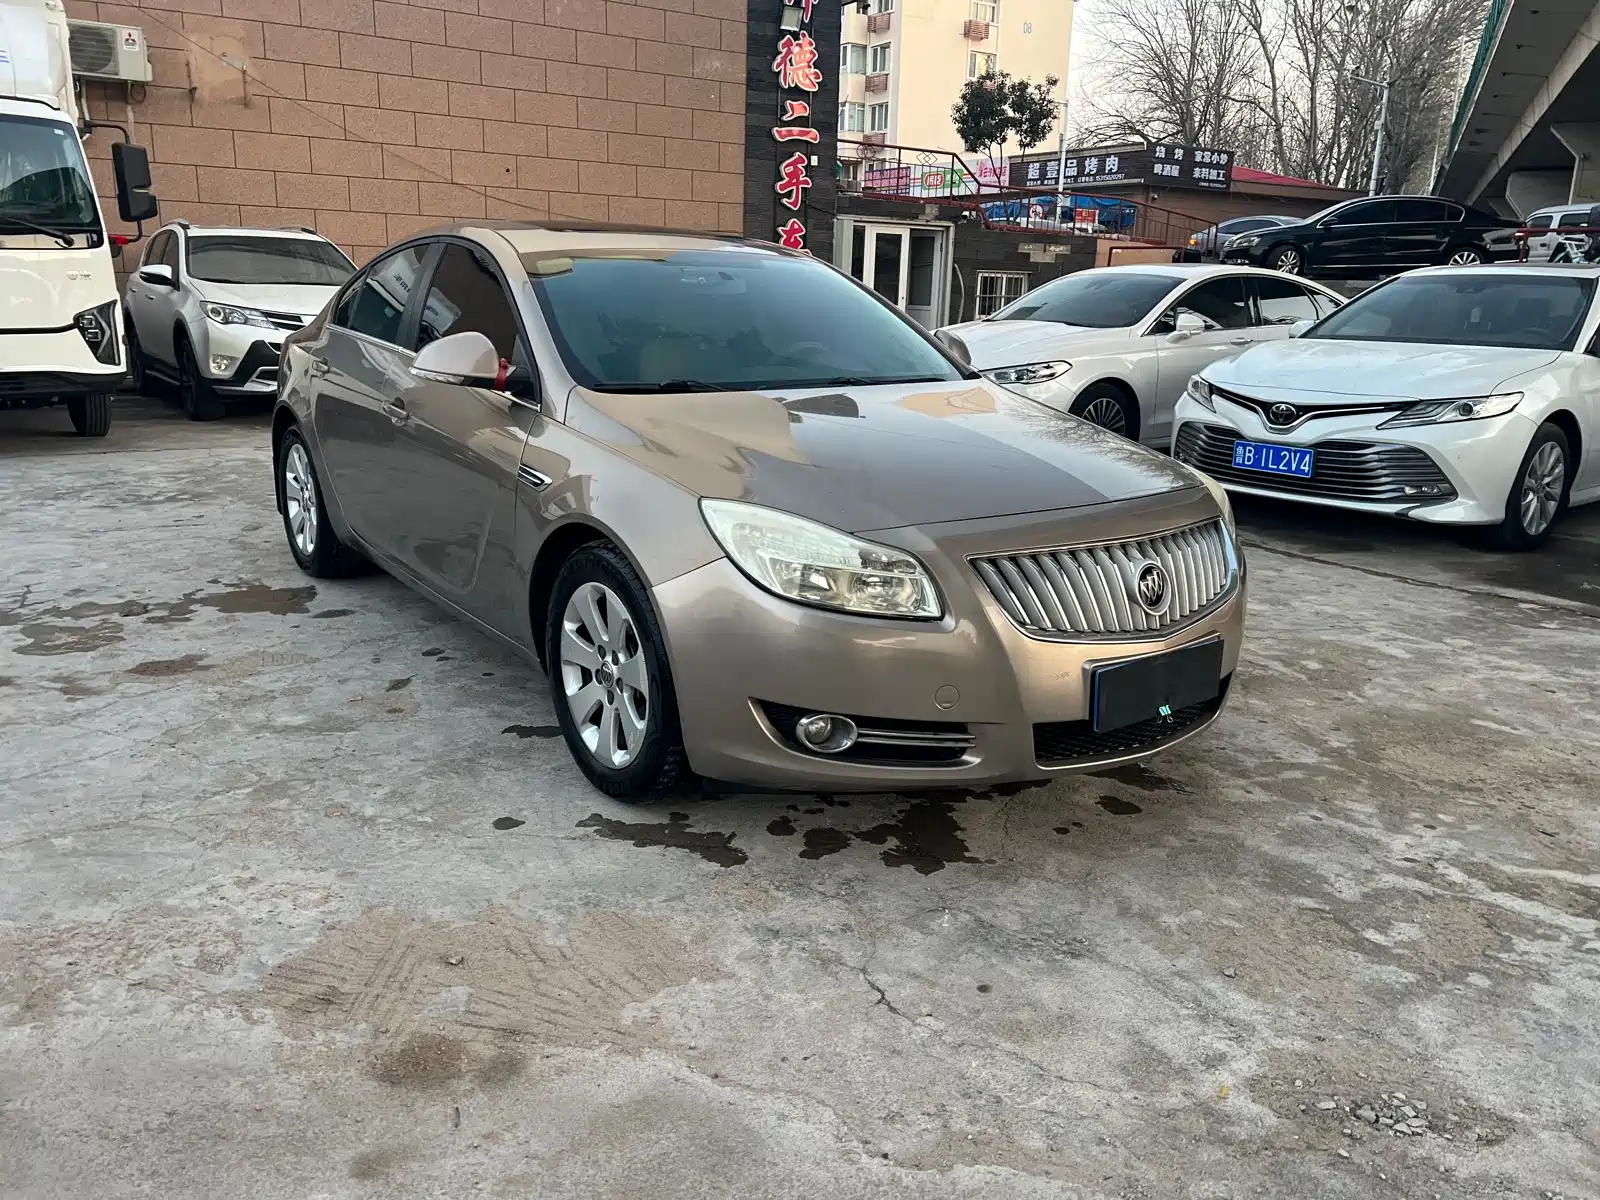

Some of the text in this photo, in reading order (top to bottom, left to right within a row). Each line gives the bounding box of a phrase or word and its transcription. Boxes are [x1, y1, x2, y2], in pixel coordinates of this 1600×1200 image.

[1194, 150, 1228, 165] 家常小炒
[1027, 155, 1119, 180] 超壹品烤肉
[1153, 163, 1180, 177] 啤酒屋
[1192, 167, 1226, 181] 来料加工
[1235, 445, 1310, 473] 鲁B·1L2V4
